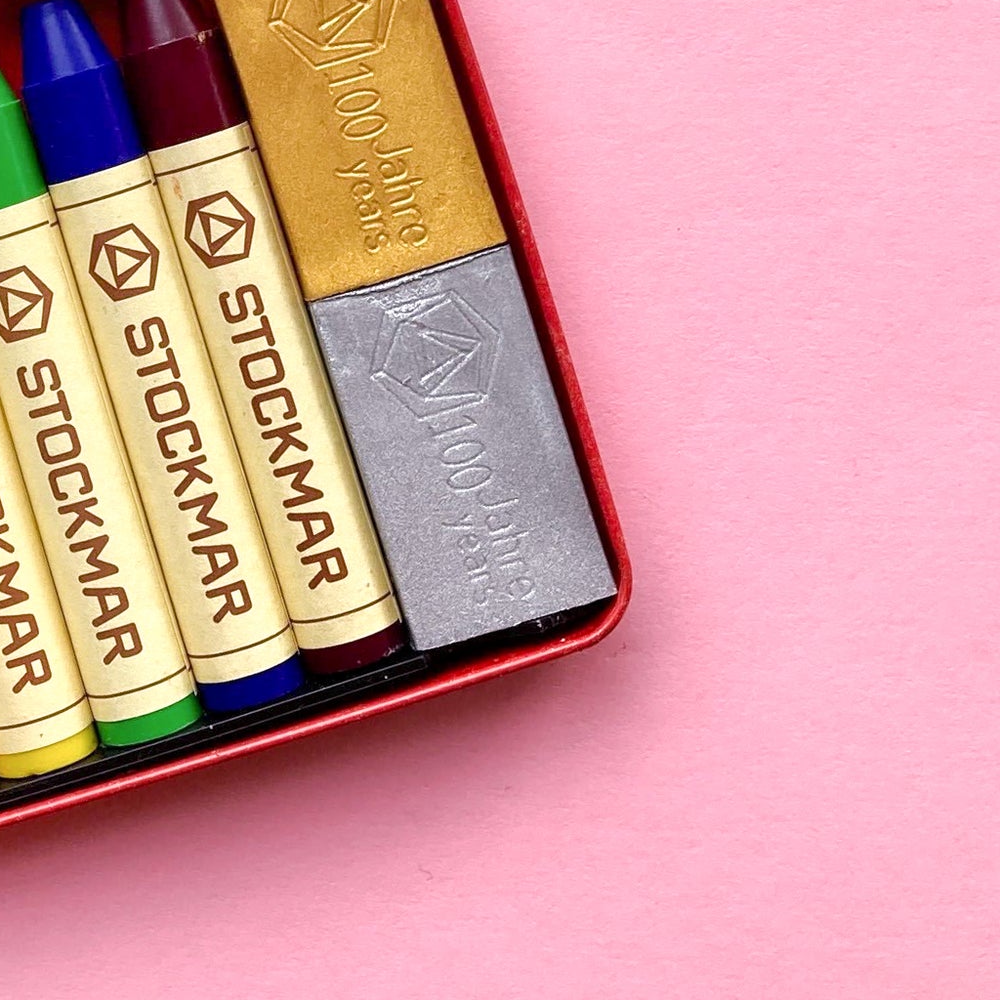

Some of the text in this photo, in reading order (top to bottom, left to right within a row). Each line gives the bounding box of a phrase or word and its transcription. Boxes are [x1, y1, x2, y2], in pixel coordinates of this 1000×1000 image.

[325, 63, 429, 249] 100 Jahre
[335, 160, 393, 254] years
[16, 358, 143, 666] STOCKMAR
[124, 316, 253, 624] STOCKMAR
[219, 283, 349, 590] STOCKMAR
[427, 415, 536, 602] 100 Jahre
[441, 513, 497, 607] years
